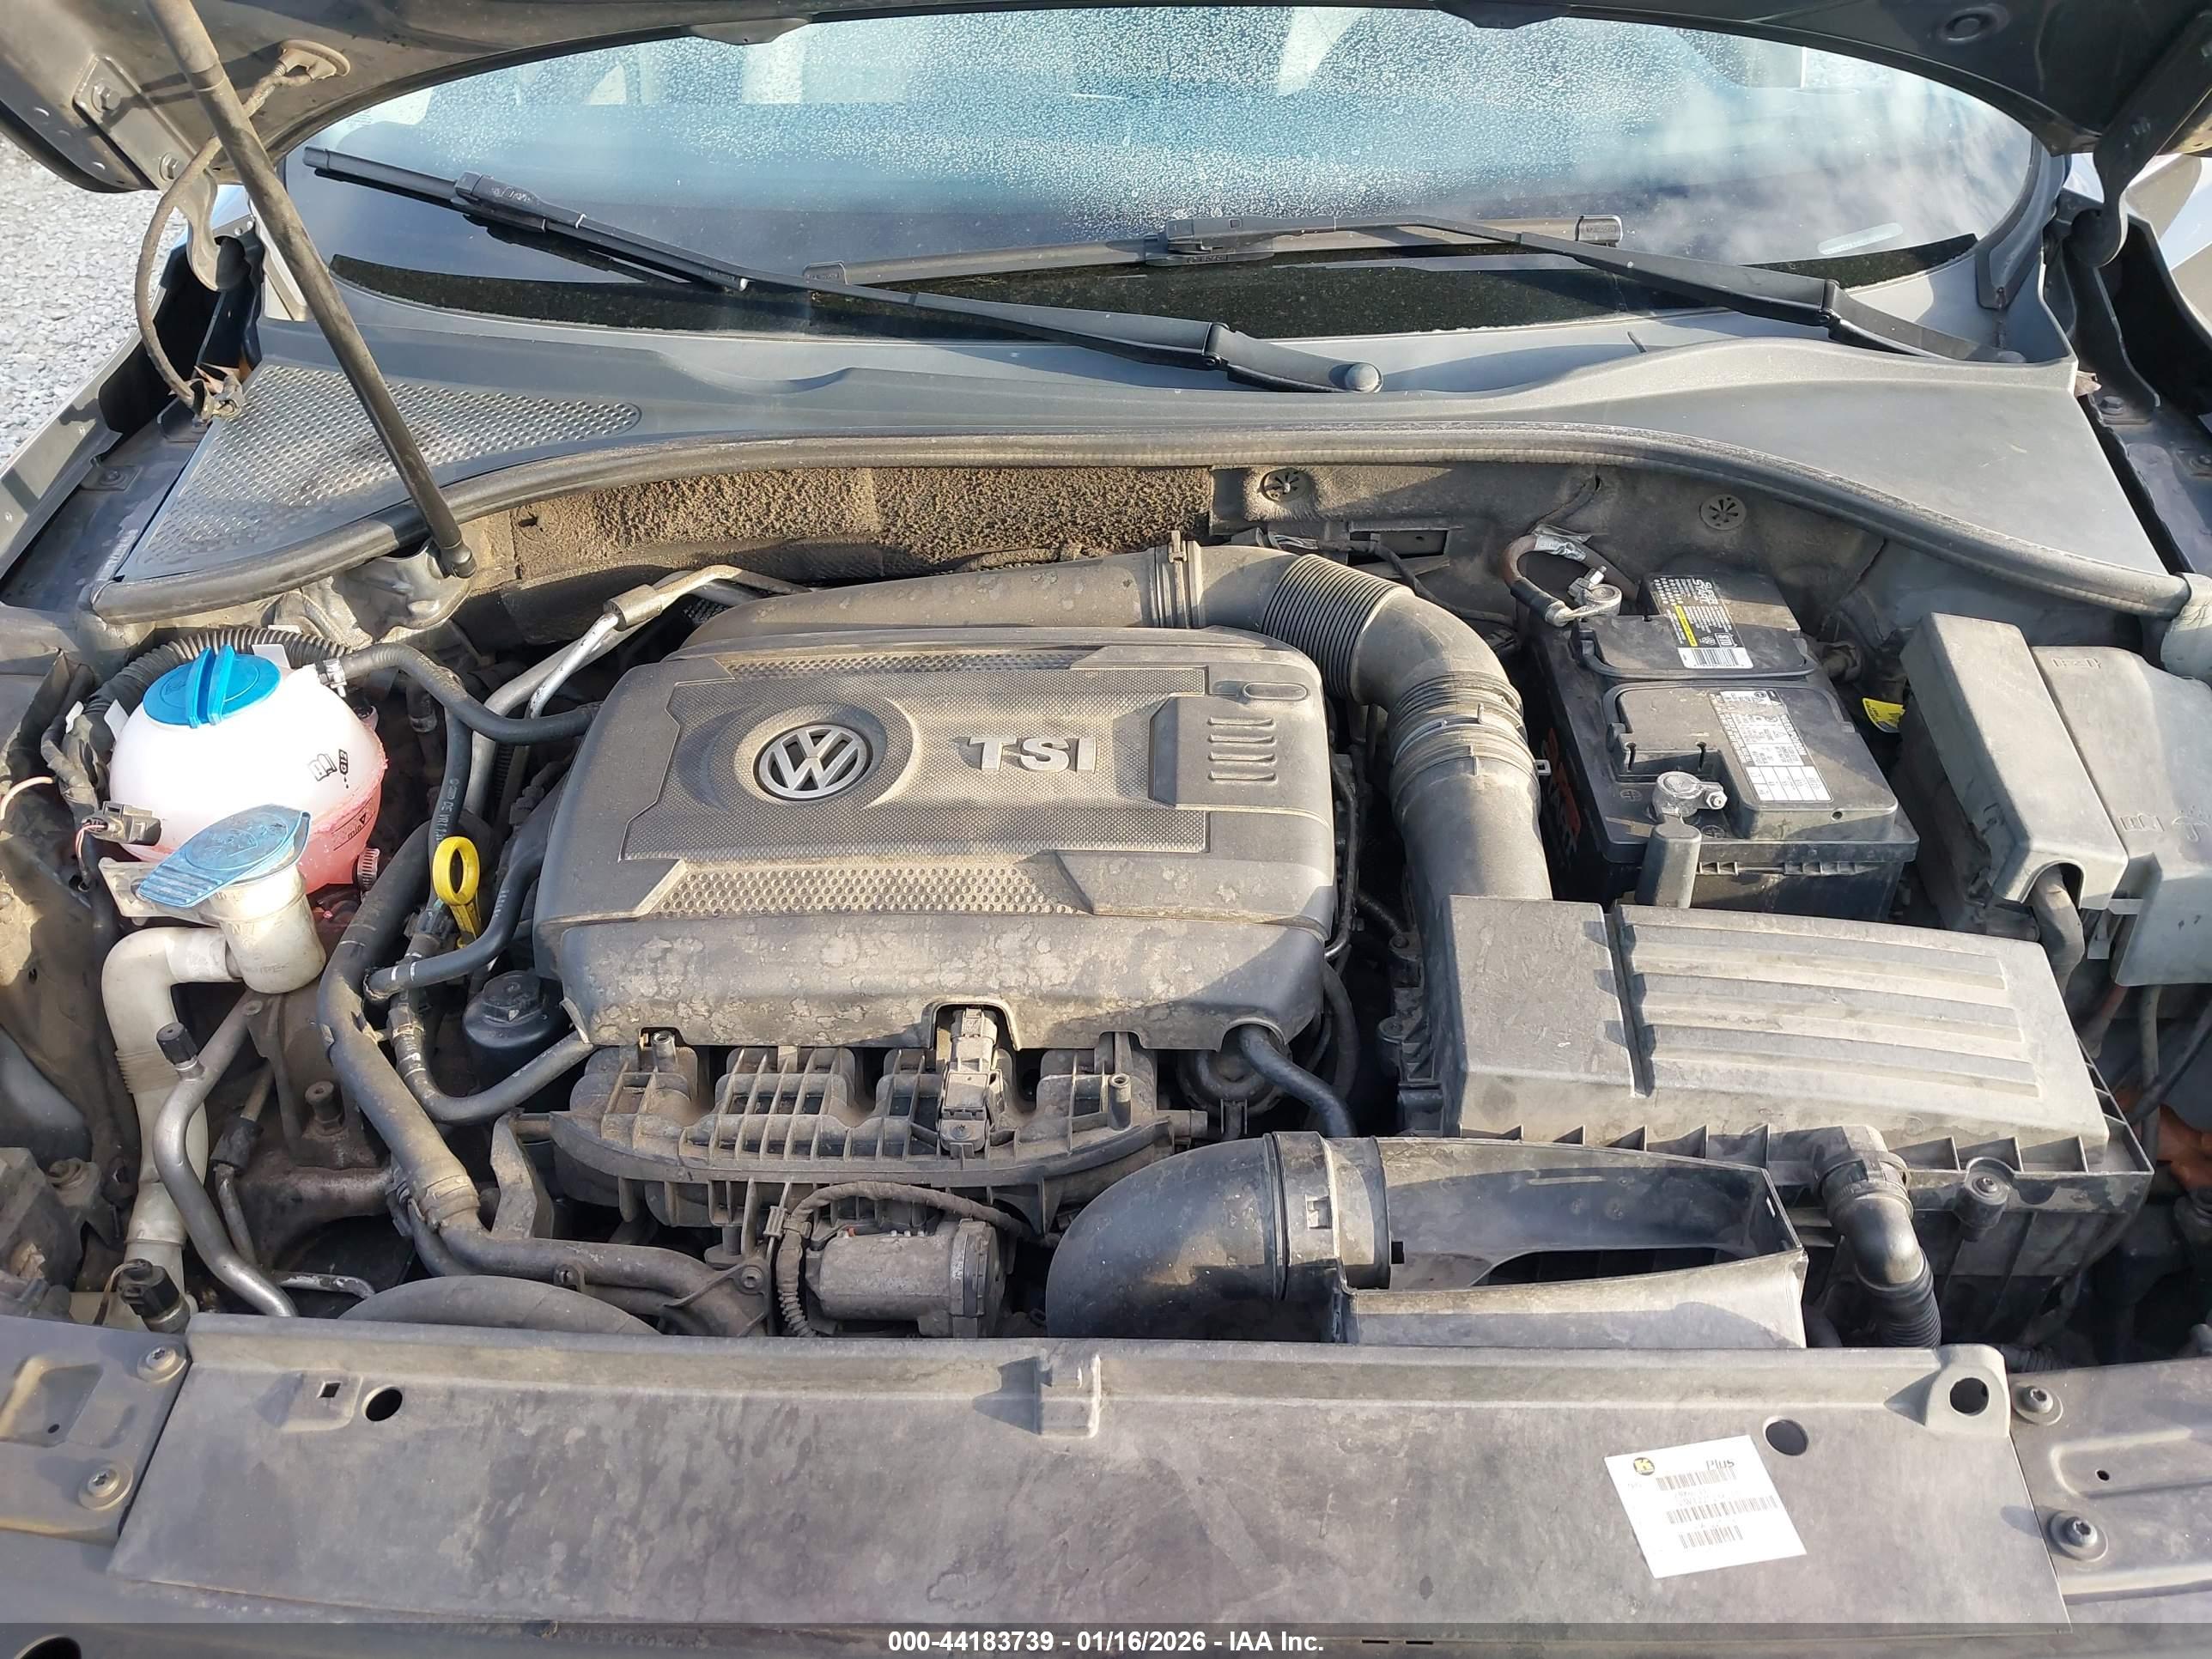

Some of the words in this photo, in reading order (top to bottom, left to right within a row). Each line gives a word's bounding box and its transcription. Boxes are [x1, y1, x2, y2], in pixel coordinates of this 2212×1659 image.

[1692, 578, 1708, 604] START
[1704, 581, 1718, 605] SUPER
[339, 750, 348, 773] G12
[969, 736, 1098, 773] TSI
[348, 824, 362, 840] min
[1705, 1459, 1735, 1470] Plus
